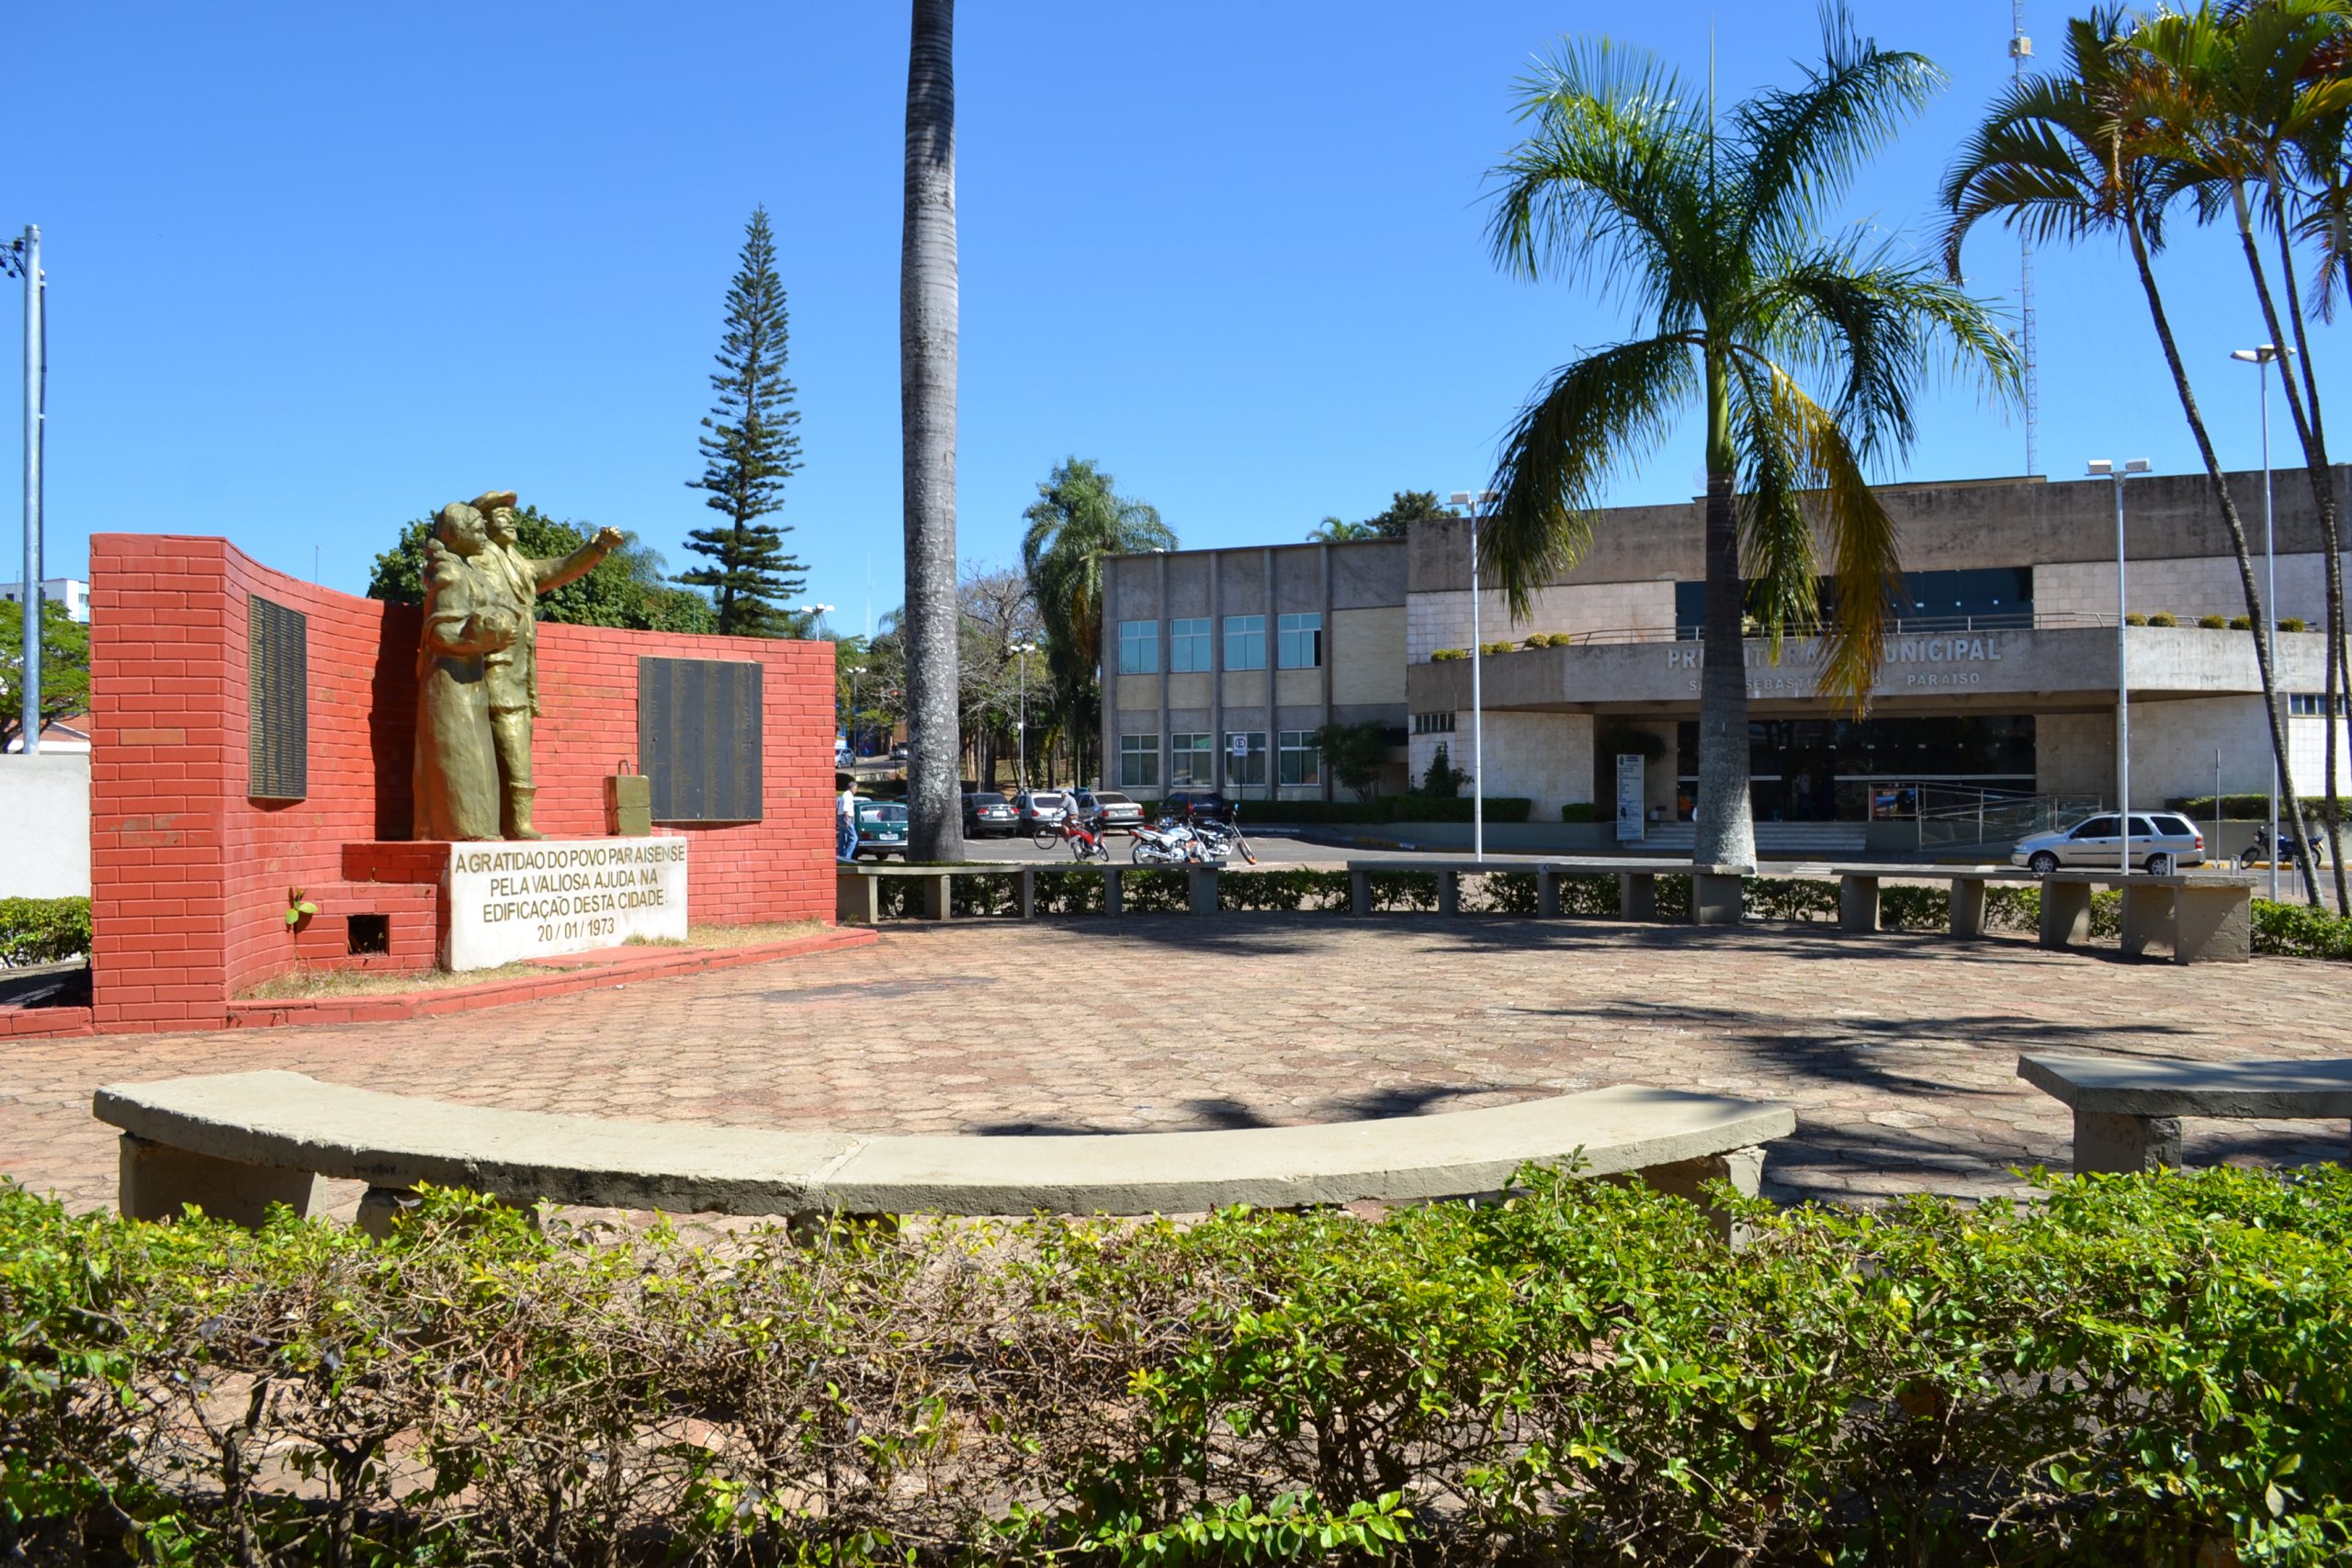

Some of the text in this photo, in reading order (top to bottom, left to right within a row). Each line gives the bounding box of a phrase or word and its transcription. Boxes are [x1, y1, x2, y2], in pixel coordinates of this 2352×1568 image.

[1884, 637, 2003, 663] UNICIPAL
[1906, 672, 1981, 687] PARAISO
[455, 844, 685, 874] A GRATIDAO DO POVO PARAISENSE
[490, 867, 658, 897] PELA VALIOSA AJUDA NA
[483, 888, 669, 923] EDIFICAÇÃO DESTA CIDADE.
